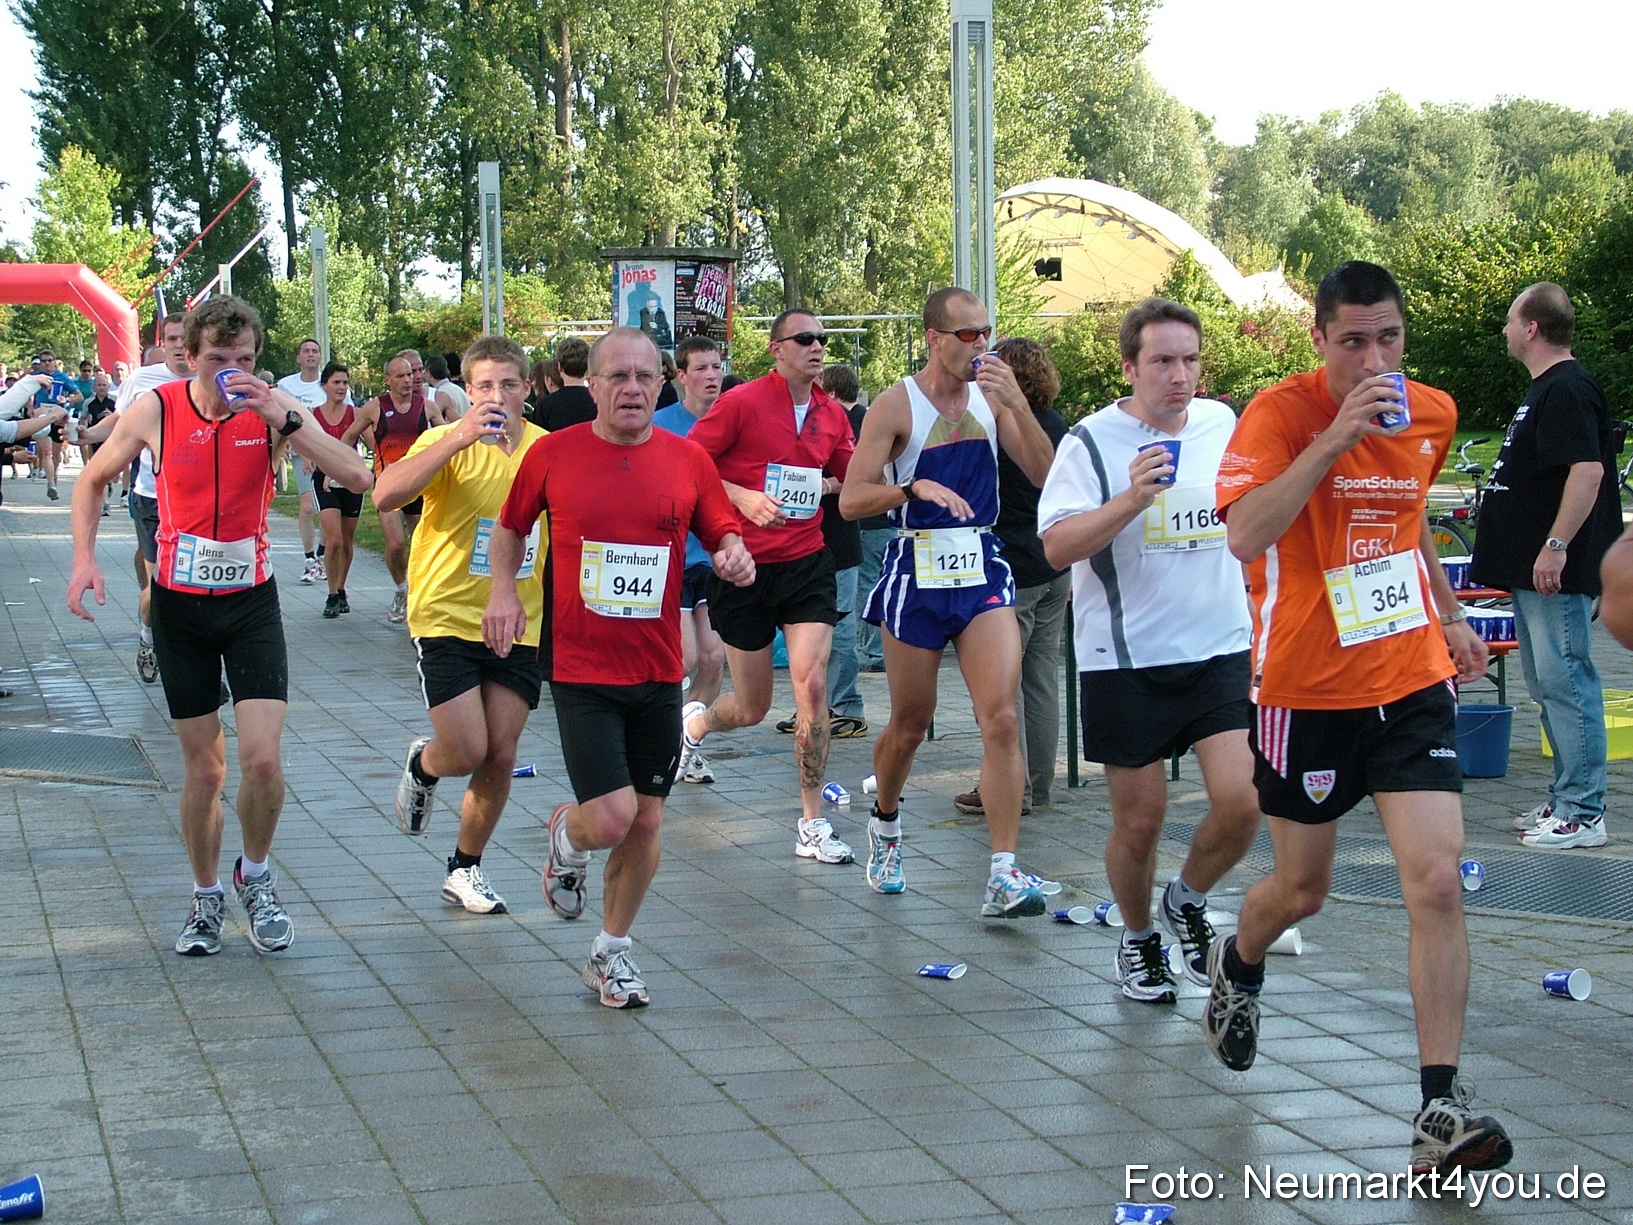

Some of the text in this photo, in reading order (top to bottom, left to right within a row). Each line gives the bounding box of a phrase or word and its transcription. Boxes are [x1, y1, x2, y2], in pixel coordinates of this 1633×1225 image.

[235, 439, 261, 447] CRAFT
[783, 470, 807, 482] Fabian
[1333, 475, 1419, 490] SportScheck
[781, 488, 816, 506] 2401
[1171, 507, 1221, 531] 1166
[198, 545, 224, 558] Jens
[1352, 538, 1390, 558] GfK
[178, 557, 184, 566] B
[605, 549, 659, 567] Bernhard
[937, 552, 978, 571] 1217
[198, 564, 250, 581] 3097
[583, 568, 590, 579] B
[1354, 559, 1392, 578] Achim
[612, 575, 653, 597] 944
[1371, 580, 1410, 612] 364
